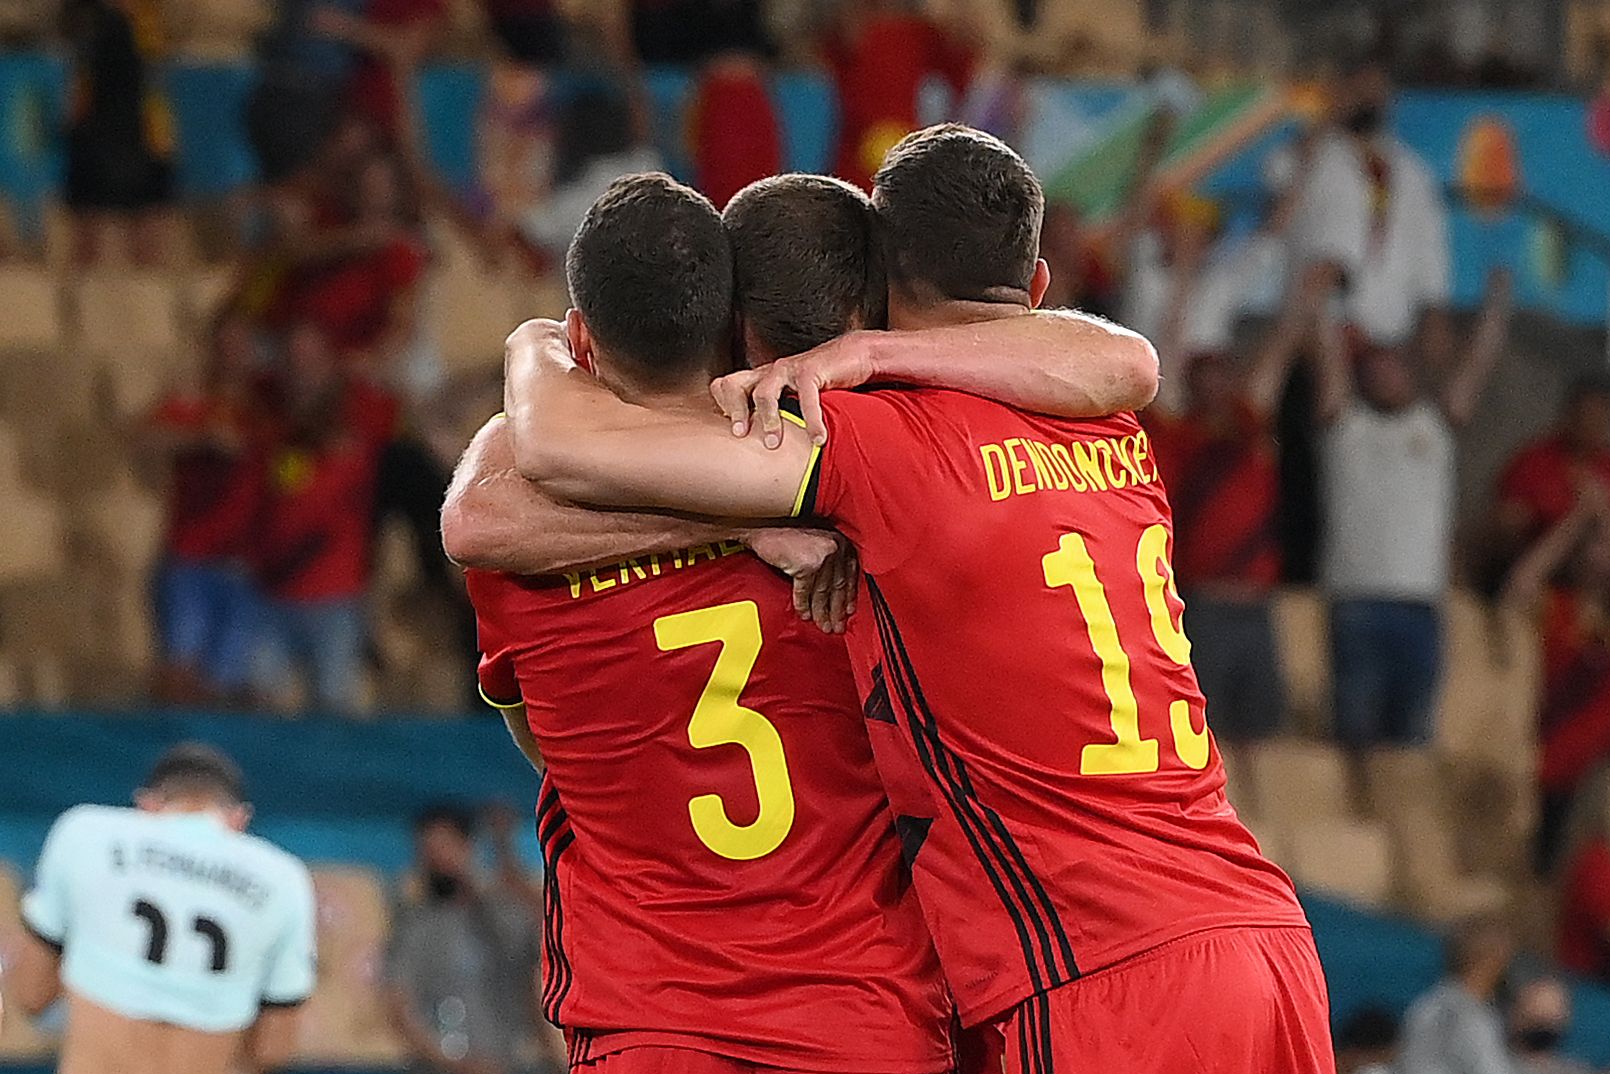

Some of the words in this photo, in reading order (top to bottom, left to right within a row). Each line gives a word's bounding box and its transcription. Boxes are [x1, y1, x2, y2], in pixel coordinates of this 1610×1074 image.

[653, 600, 795, 860] 3
[1042, 524, 1210, 775] 19
[133, 898, 227, 972] 11
